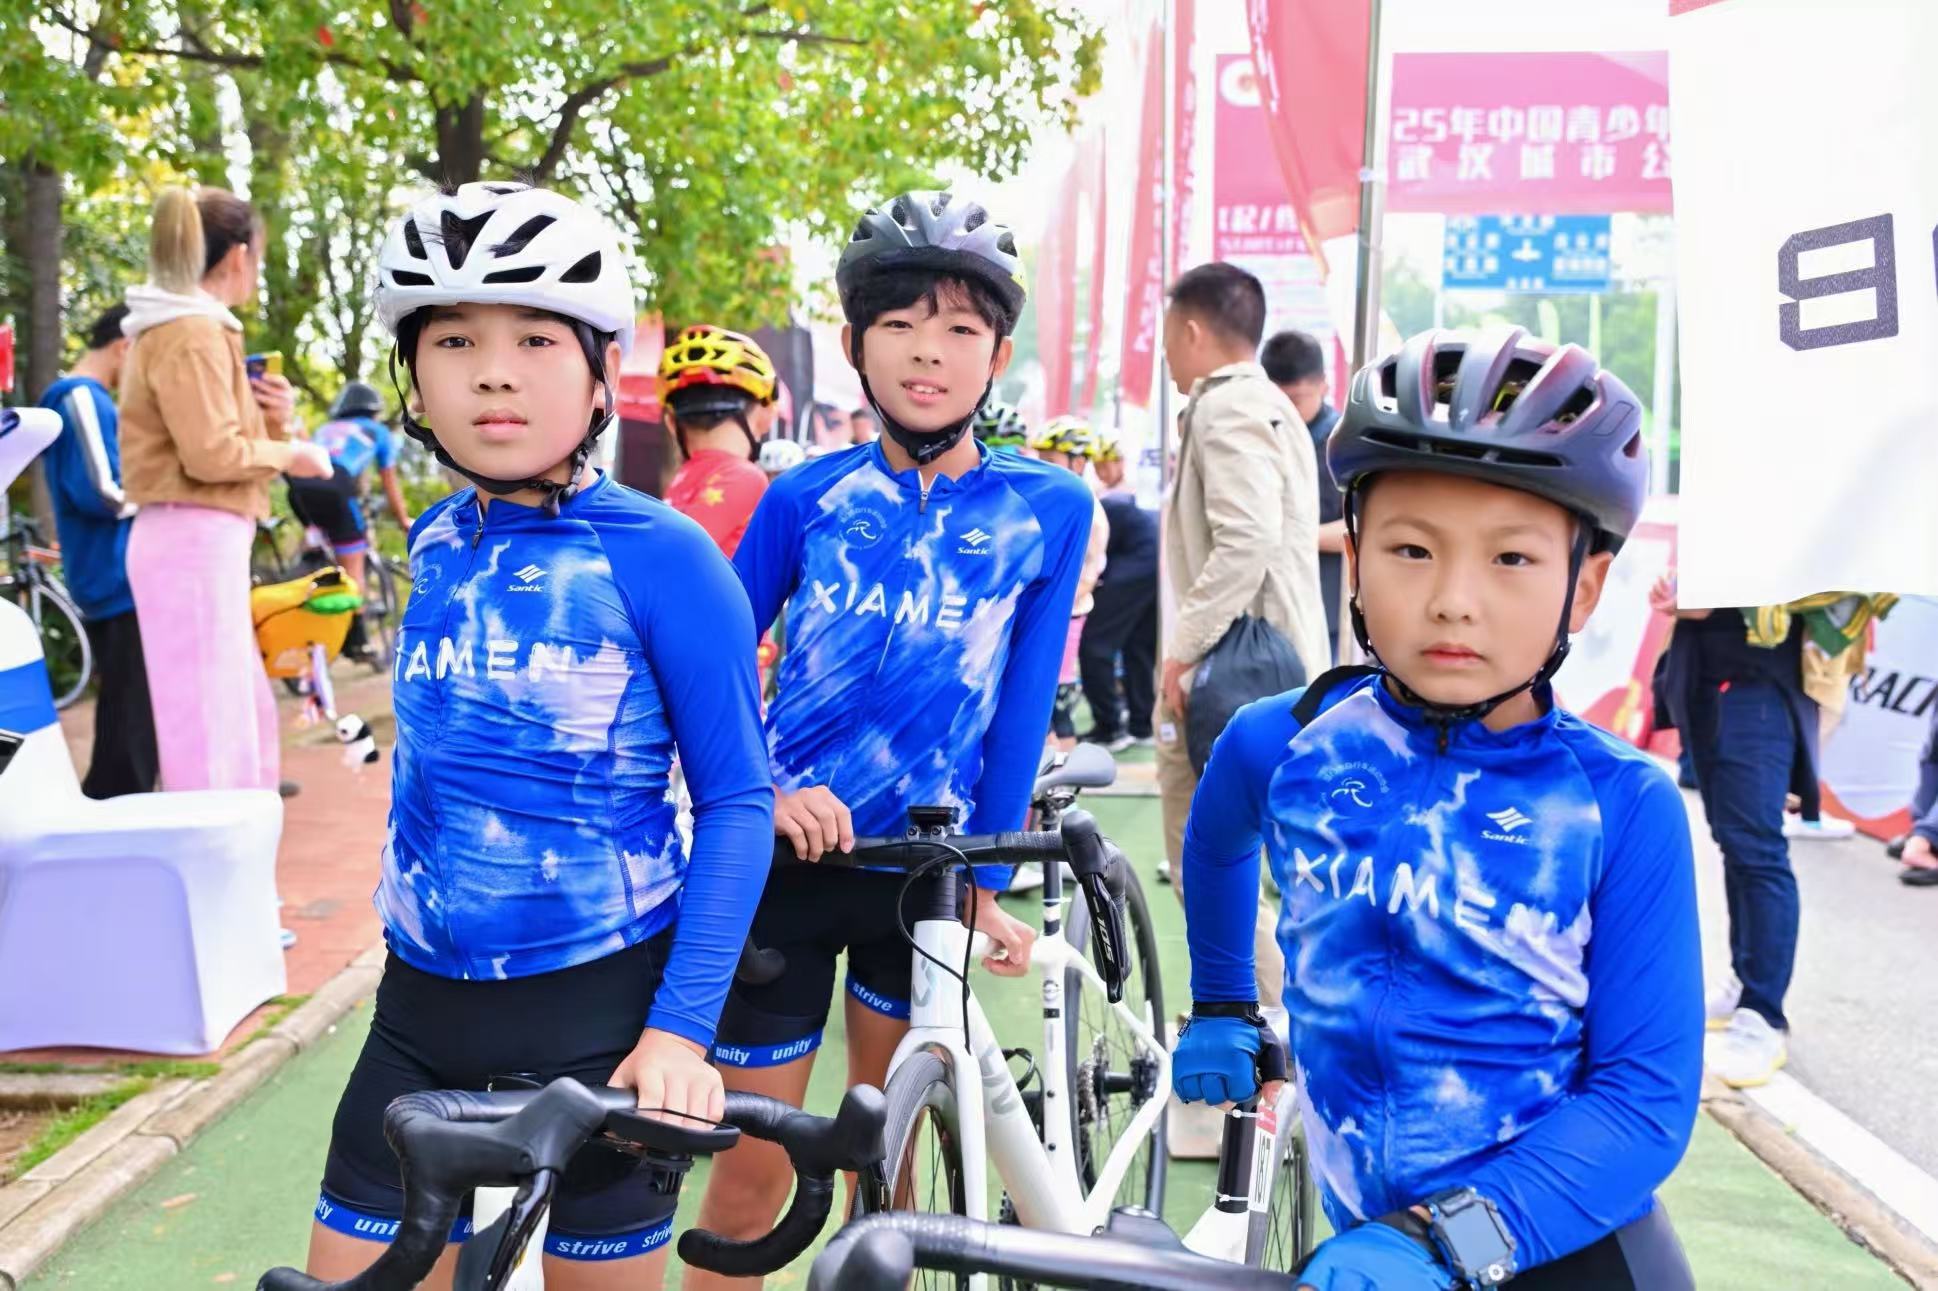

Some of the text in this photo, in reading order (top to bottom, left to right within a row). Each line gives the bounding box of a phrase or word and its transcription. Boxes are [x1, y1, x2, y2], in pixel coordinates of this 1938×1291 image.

[957, 547, 990, 556] Santic
[507, 584, 544, 593] Santic
[395, 637, 573, 683] IAMEN
[1480, 829, 1530, 846] Santic
[852, 982, 893, 1012] strive
[715, 1038, 812, 1065] unity unity
[317, 1196, 402, 1236] ity uni
[557, 1240, 627, 1255] strive
